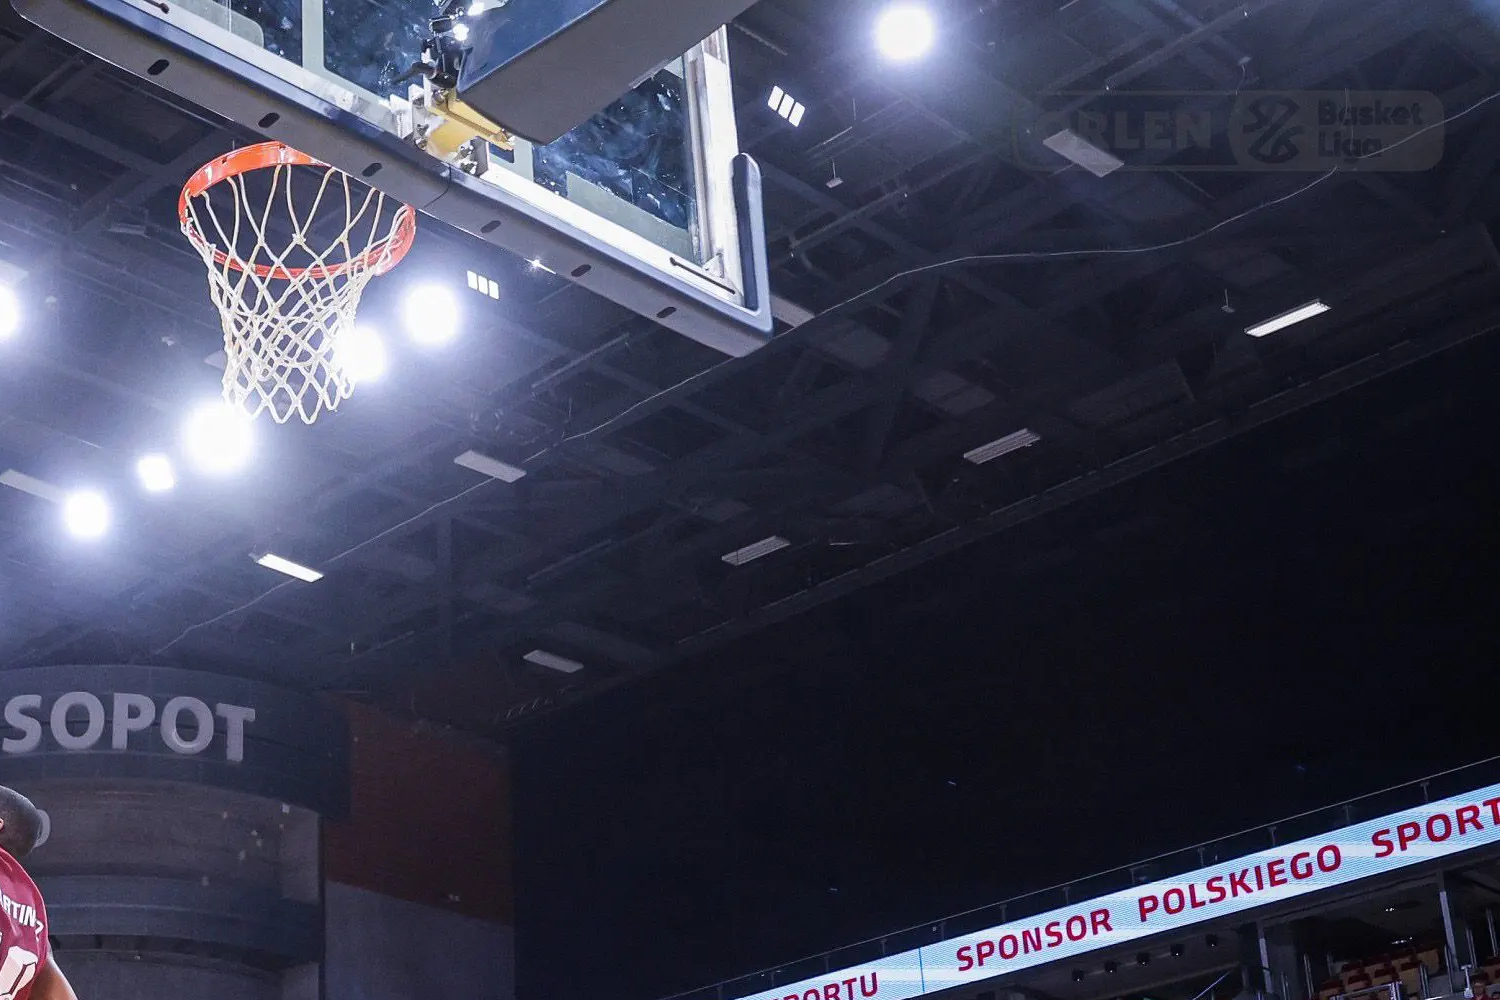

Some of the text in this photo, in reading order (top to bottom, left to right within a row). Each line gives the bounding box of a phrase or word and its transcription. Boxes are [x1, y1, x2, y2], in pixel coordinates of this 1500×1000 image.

[1, 691, 256, 762] SOPOT
[955, 844, 1342, 972] SPONSOR POLSKIEGO
